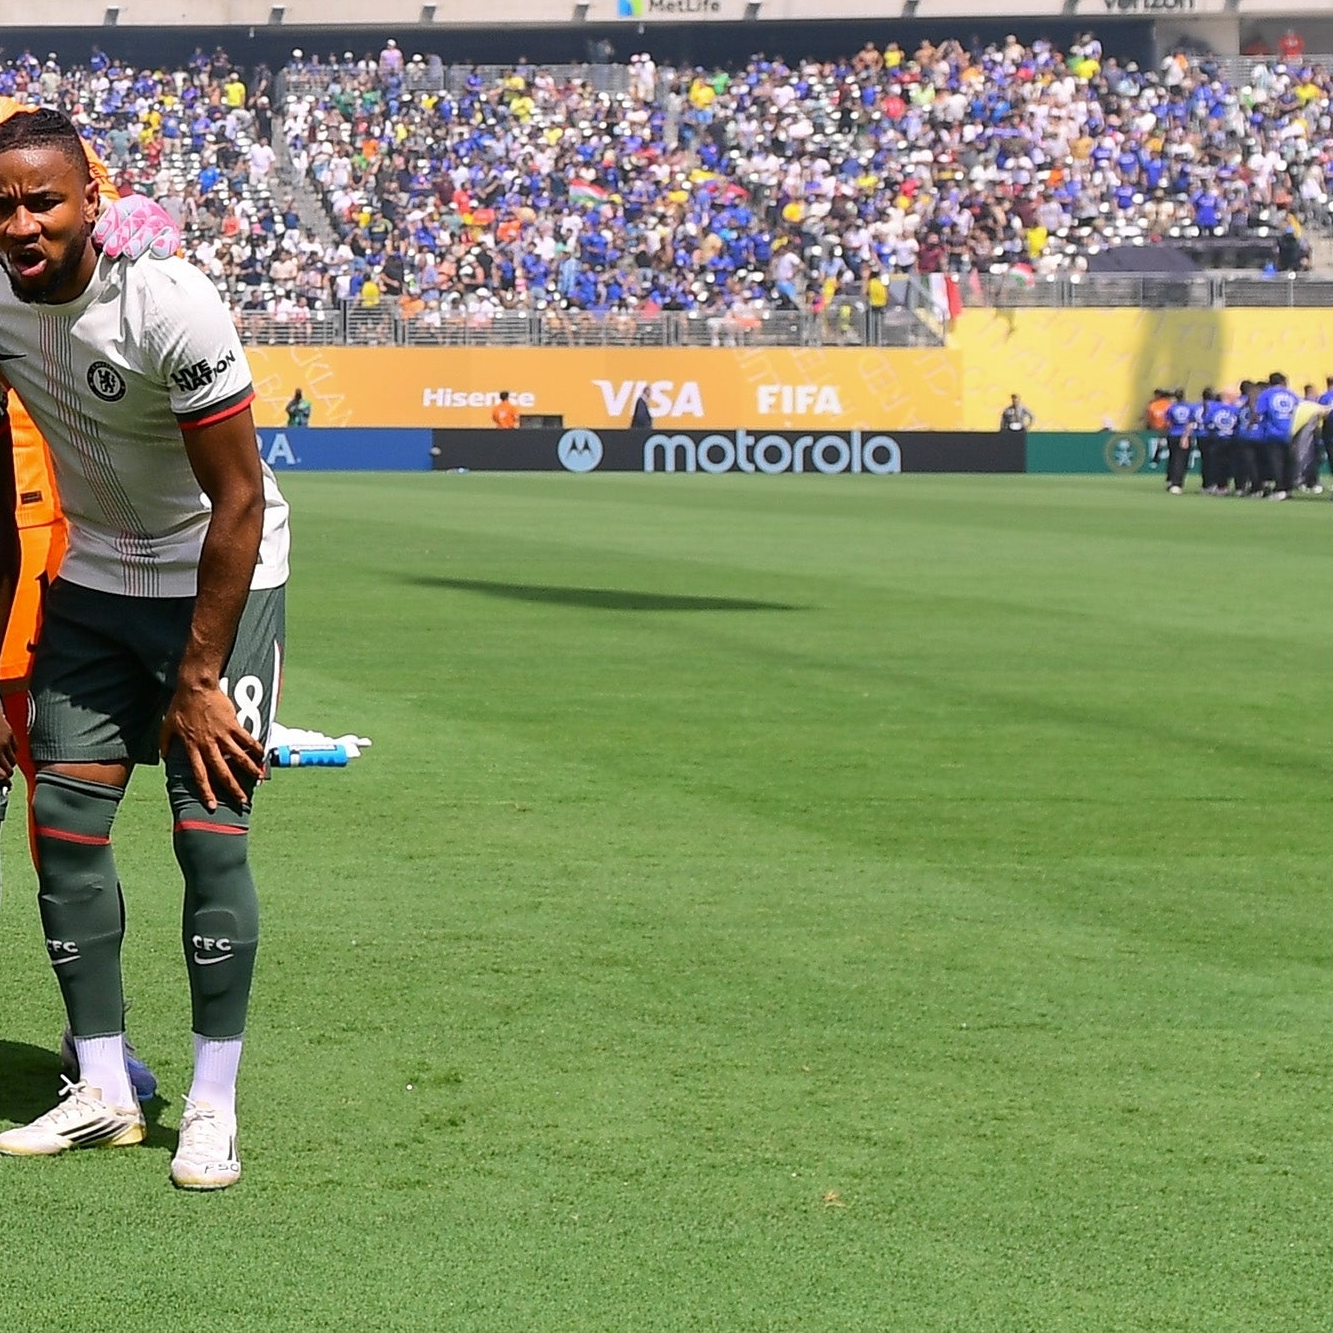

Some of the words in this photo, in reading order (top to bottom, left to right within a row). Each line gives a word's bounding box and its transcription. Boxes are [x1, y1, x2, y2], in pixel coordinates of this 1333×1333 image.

[179, 350, 236, 392] NATION
[422, 388, 536, 408] Hisense
[758, 385, 842, 415] FIFA
[643, 429, 902, 474] motorola
[193, 935, 232, 952] CFC
